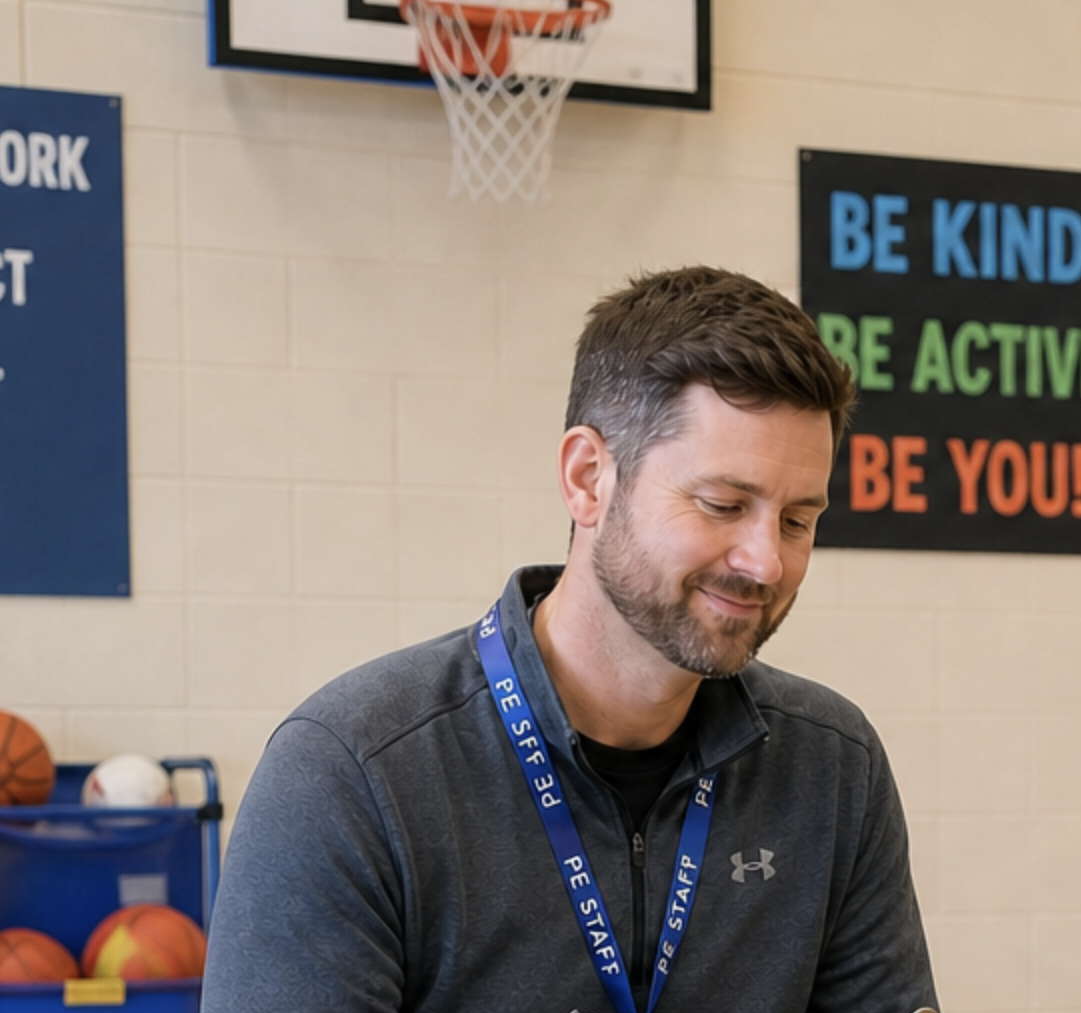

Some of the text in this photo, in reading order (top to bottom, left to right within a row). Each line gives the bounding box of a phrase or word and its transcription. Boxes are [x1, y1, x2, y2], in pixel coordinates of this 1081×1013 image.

[829, 191, 909, 274] BE
[818, 313, 894, 391] BE
[849, 434, 928, 514] BE
[495, 677, 522, 713] PE
[563, 855, 620, 975] PE STAFF
